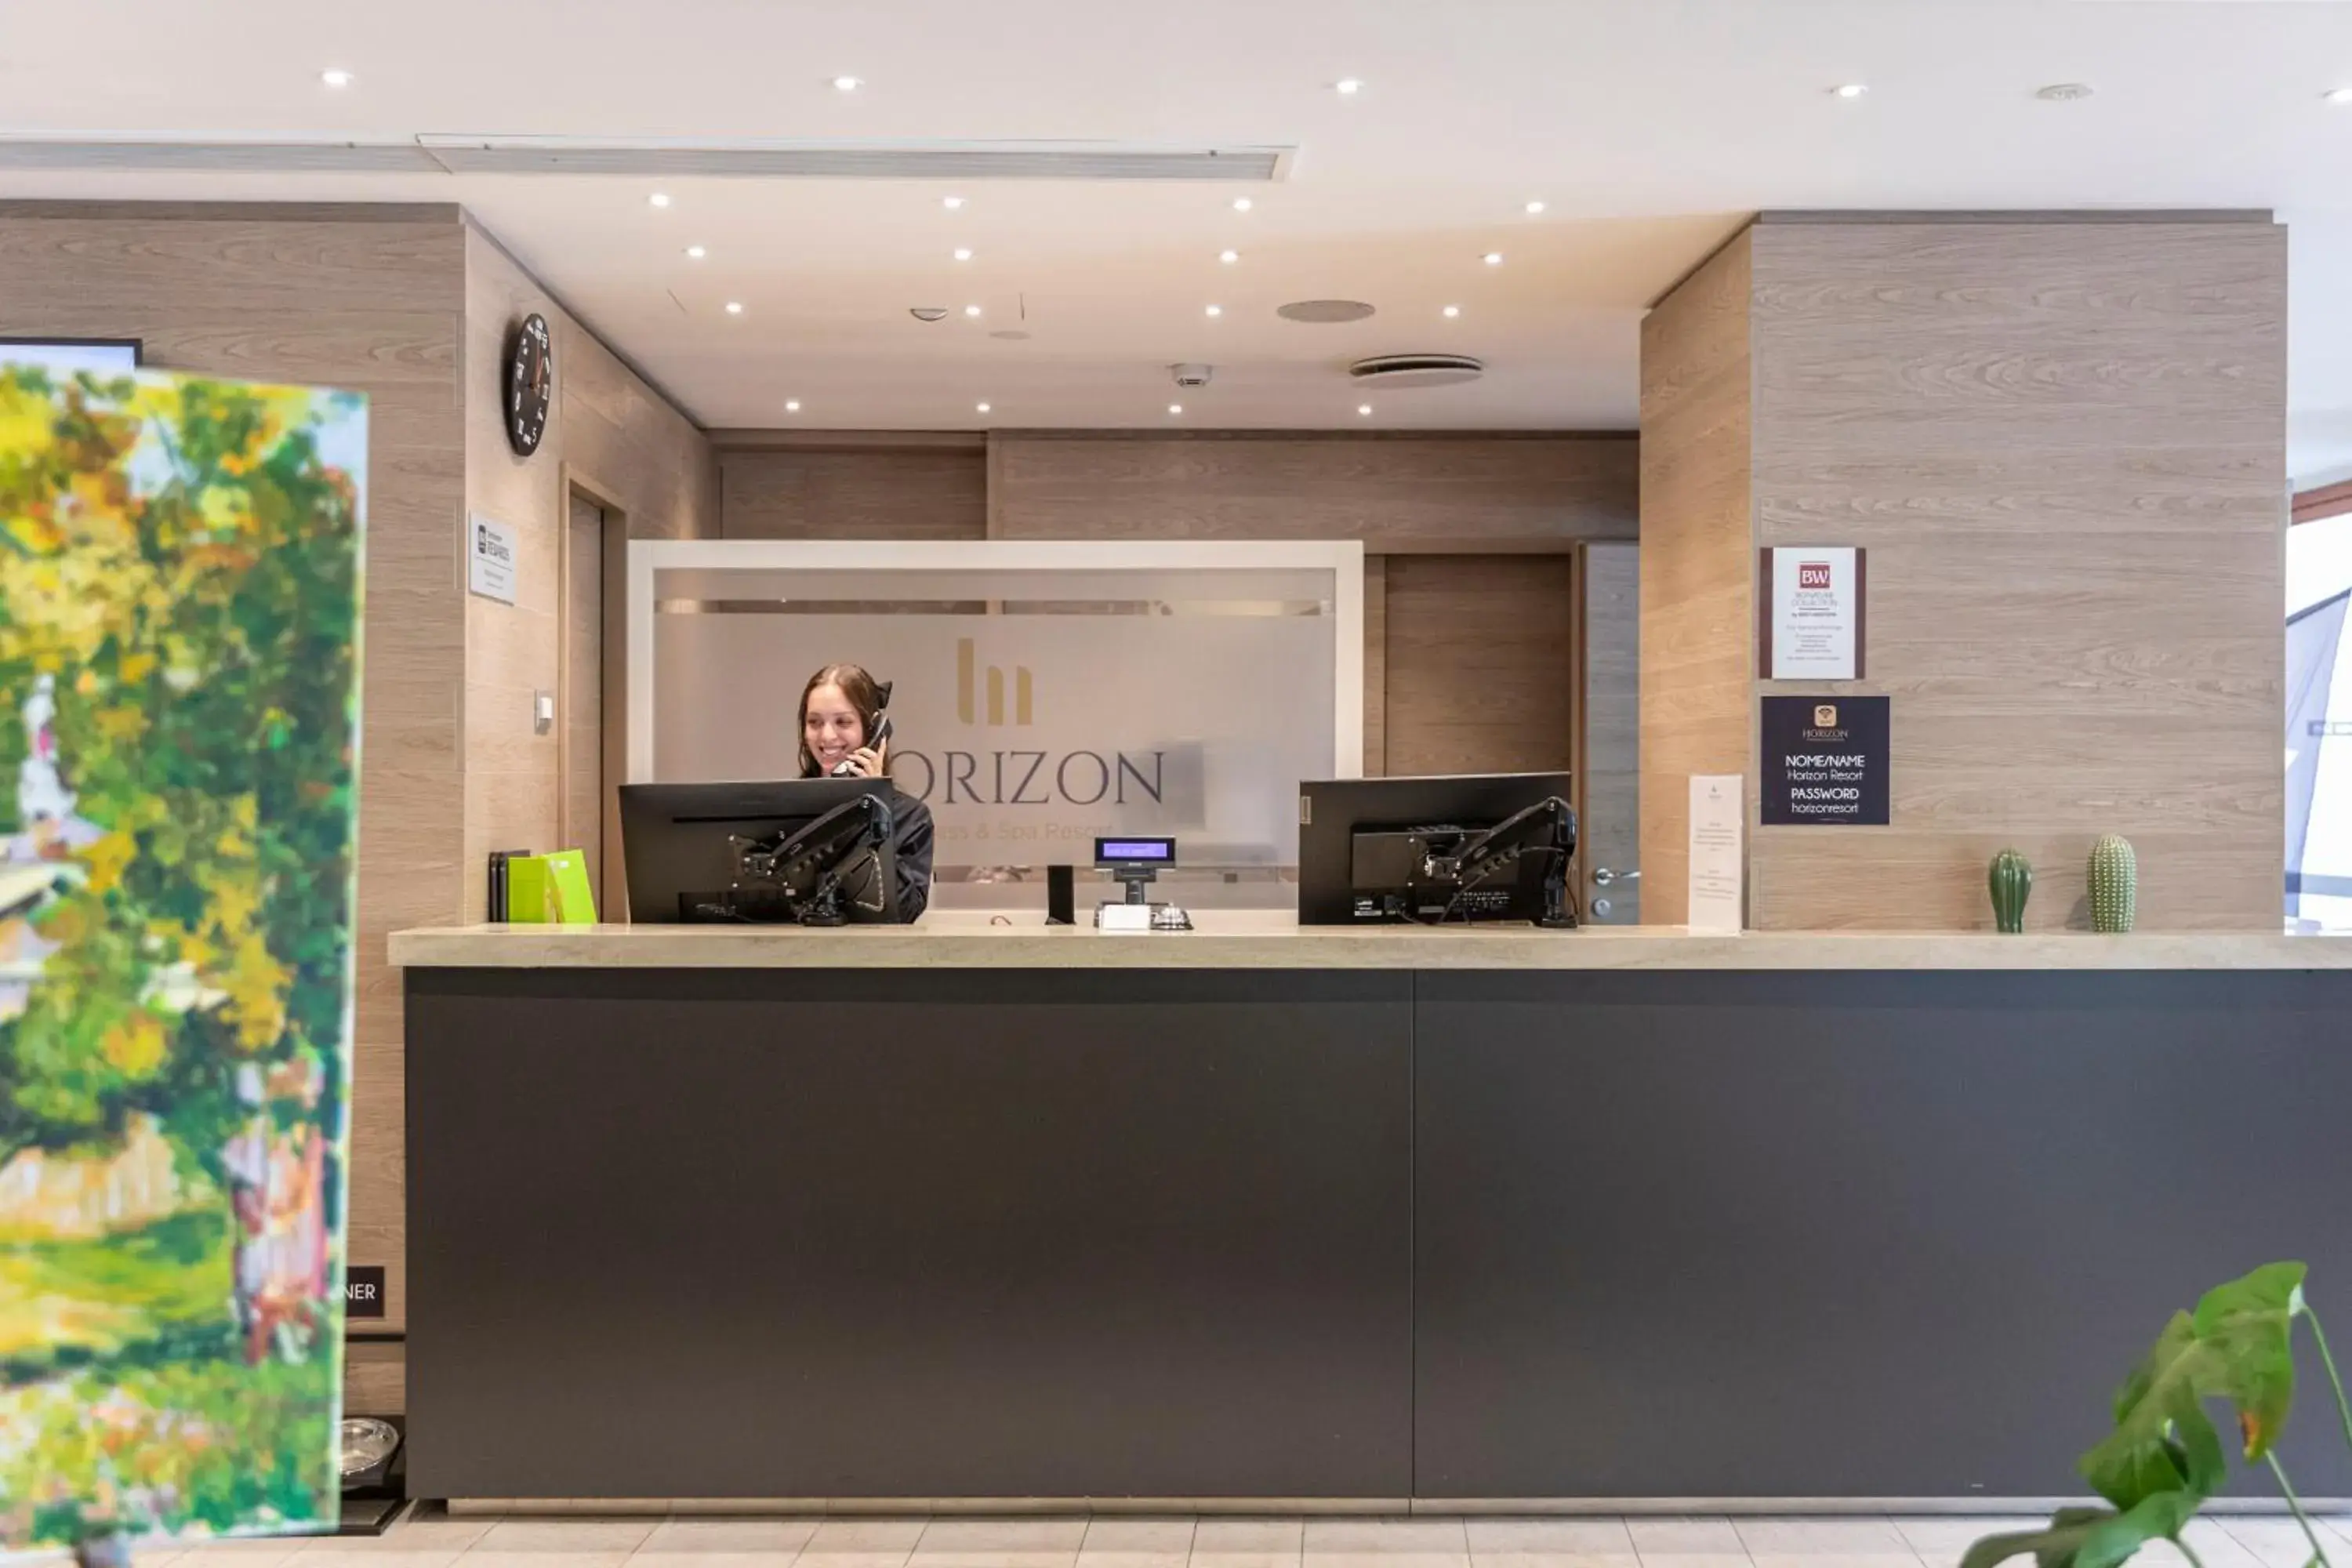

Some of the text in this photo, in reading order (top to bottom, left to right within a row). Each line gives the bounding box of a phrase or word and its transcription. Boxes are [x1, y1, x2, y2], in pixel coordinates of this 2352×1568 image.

[1802, 571, 1828, 584] BW
[1785, 755, 1865, 768] NOME/NAME
[890, 750, 1166, 804] ORIZON
[1787, 769, 1863, 780] Horizon Resort
[1791, 788, 1859, 799] PASSWORD
[1791, 802, 1859, 813] horizonresort
[345, 1283, 376, 1300] NER
